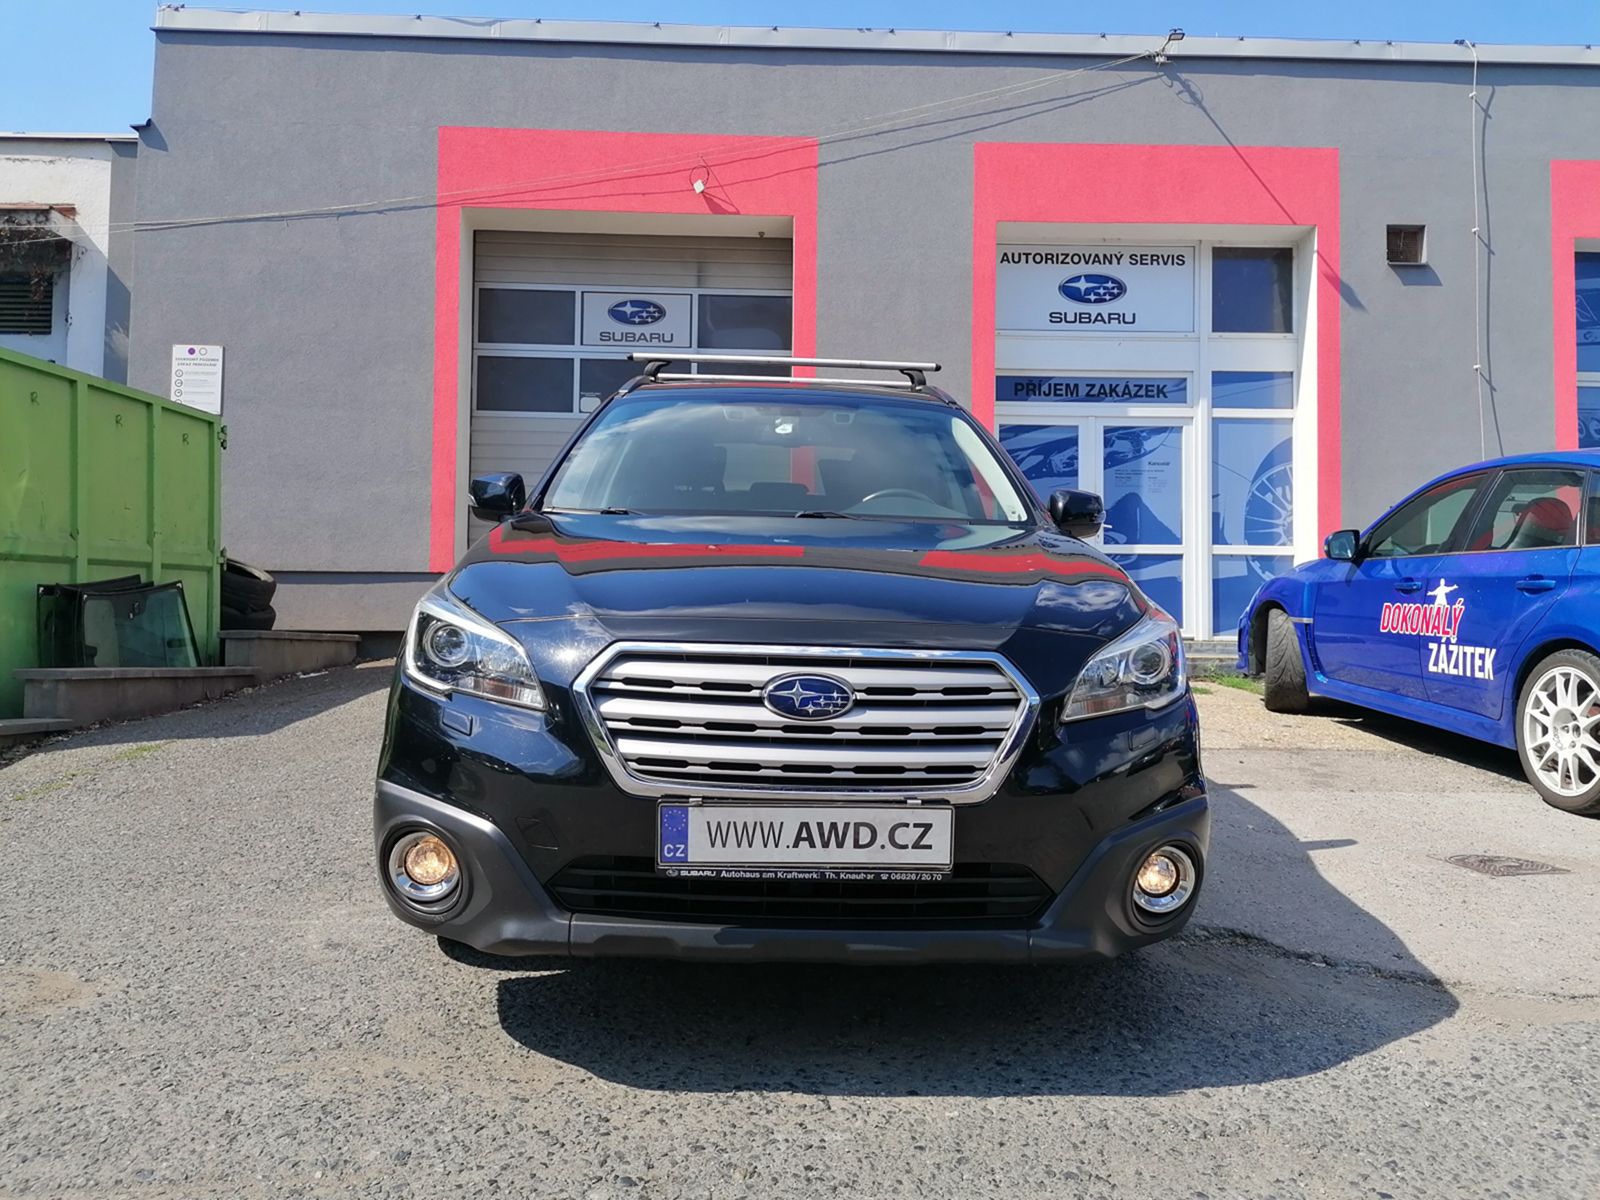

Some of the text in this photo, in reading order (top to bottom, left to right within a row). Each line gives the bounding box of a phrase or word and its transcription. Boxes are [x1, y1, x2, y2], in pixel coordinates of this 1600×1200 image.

[1000, 251, 1186, 266] AUTORIZOVANÝ SERVIS
[1049, 312, 1136, 325] SUBARU
[599, 331, 674, 343] SUBARU
[1013, 379, 1168, 399] PŘÍJEM ZAKÁZEK
[1380, 598, 1465, 638] DOKONALÝ
[1428, 636, 1497, 681] ZÁŽITEK
[706, 820, 933, 850] WWW.AWD.CZ
[664, 844, 685, 858] CZ
[720, 870, 760, 878] Autohaus
[825, 871, 838, 879] Th.
